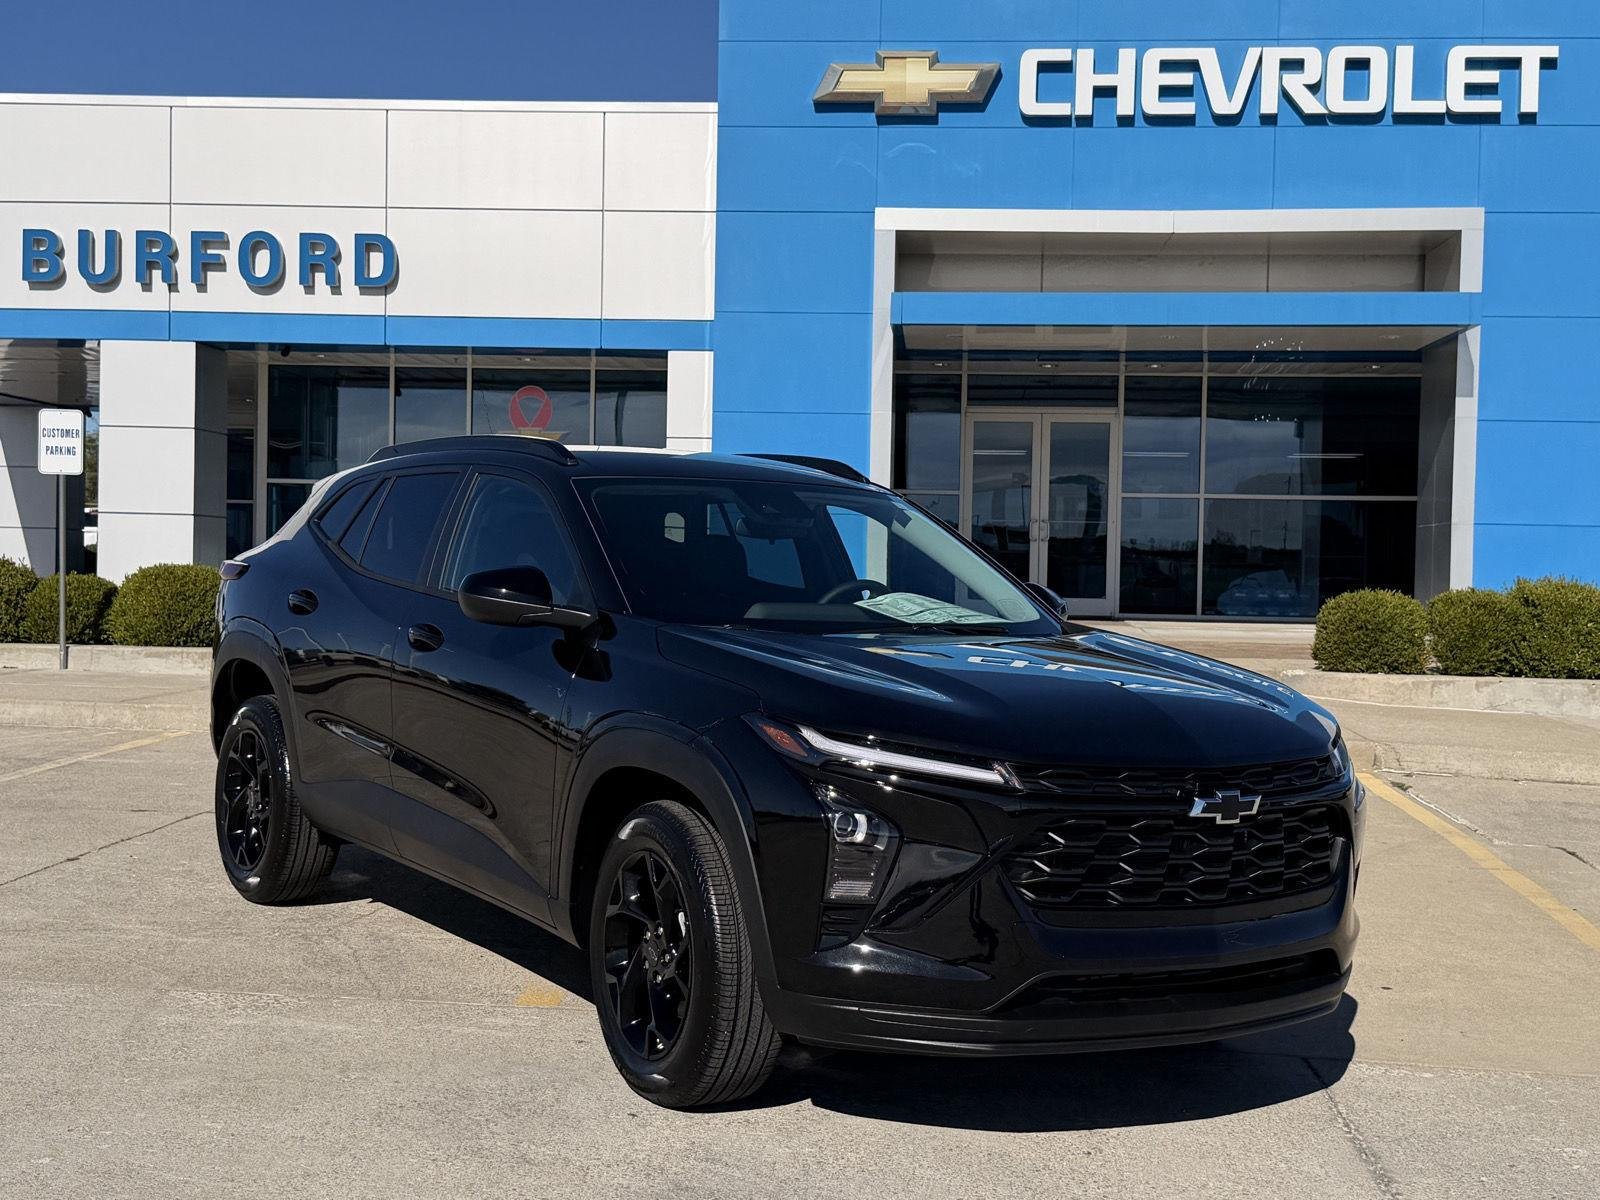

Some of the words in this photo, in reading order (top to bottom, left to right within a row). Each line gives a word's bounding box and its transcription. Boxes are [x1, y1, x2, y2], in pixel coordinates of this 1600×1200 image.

[1019, 45, 1559, 117] CHEVROLET
[22, 228, 398, 289] BURFORD
[42, 427, 80, 438] CUSTOMER
[45, 445, 77, 456] PARKING
